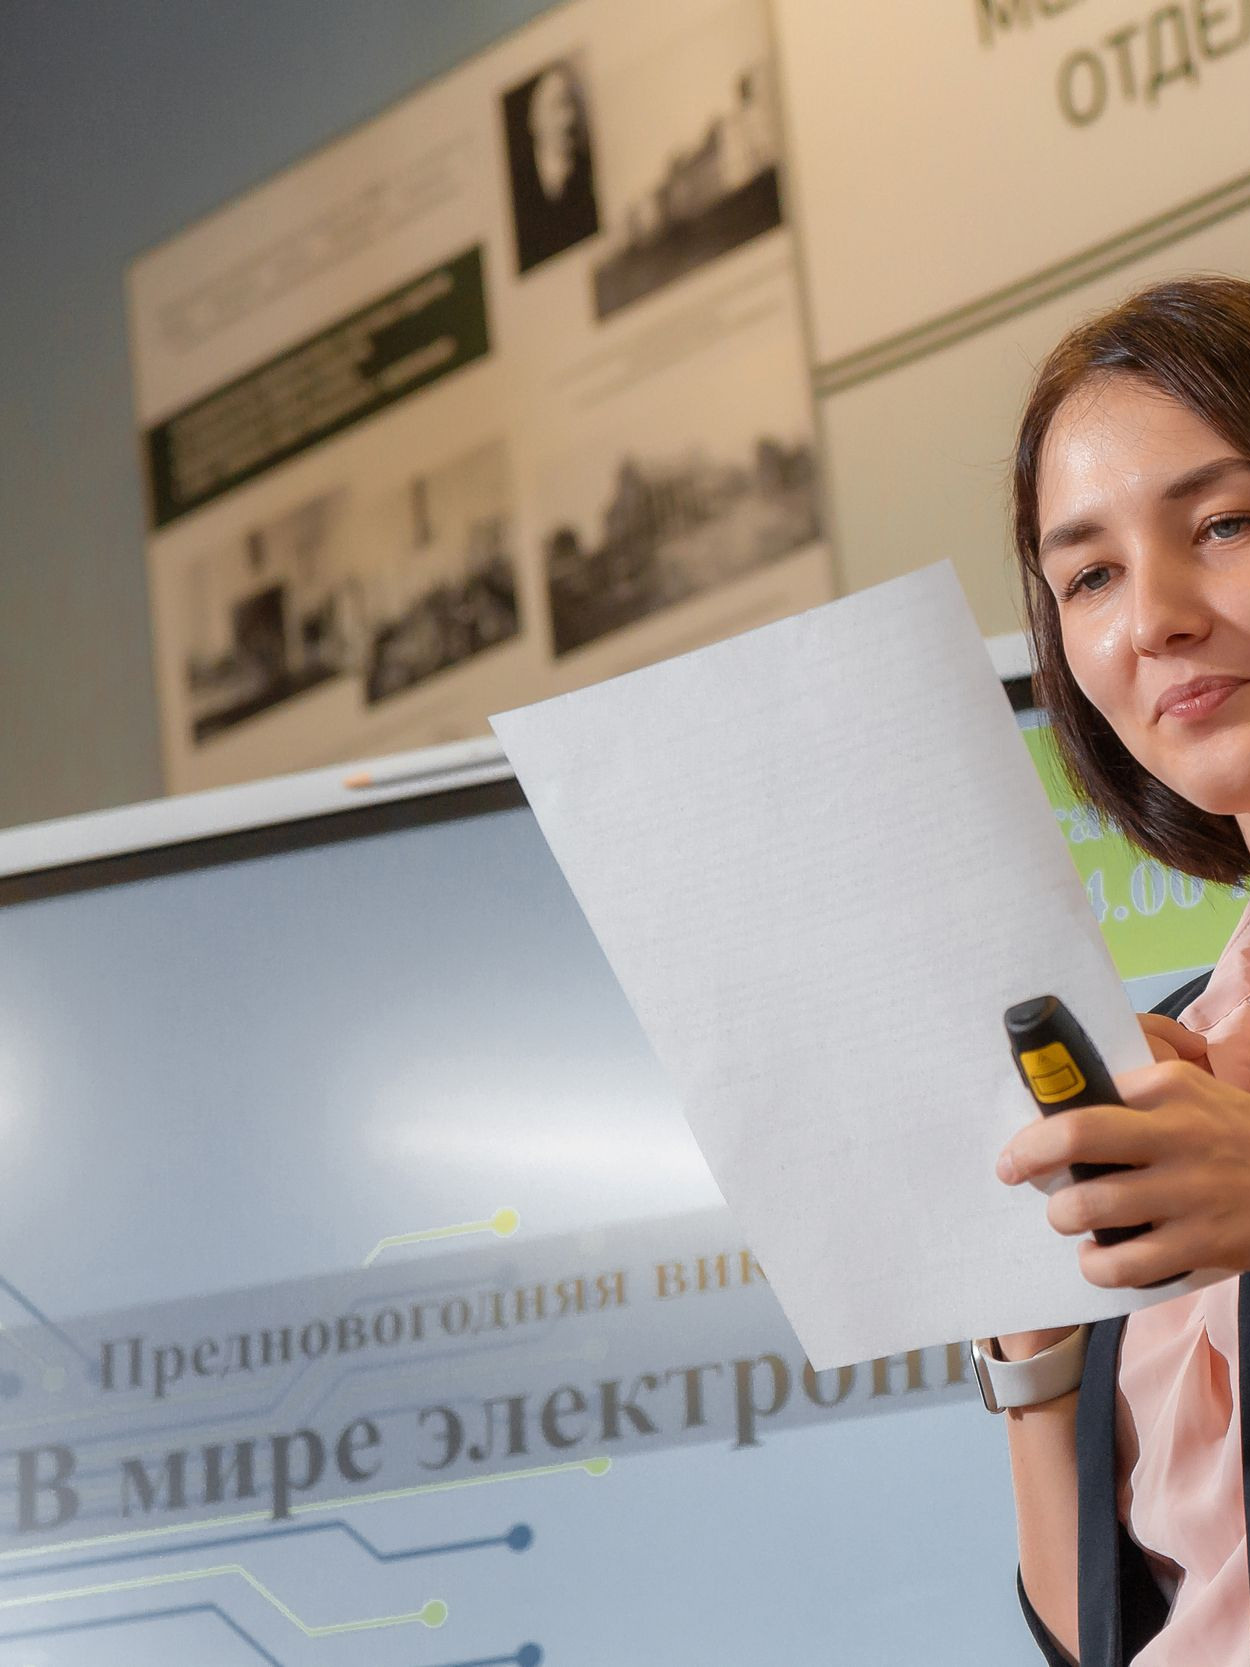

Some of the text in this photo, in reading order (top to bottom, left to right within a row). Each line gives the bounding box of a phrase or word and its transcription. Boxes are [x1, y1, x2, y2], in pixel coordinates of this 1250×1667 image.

[101, 1270, 628, 1400] Предновогодняя
[16, 1443, 81, 1533] В
[120, 1415, 383, 1521] мире
